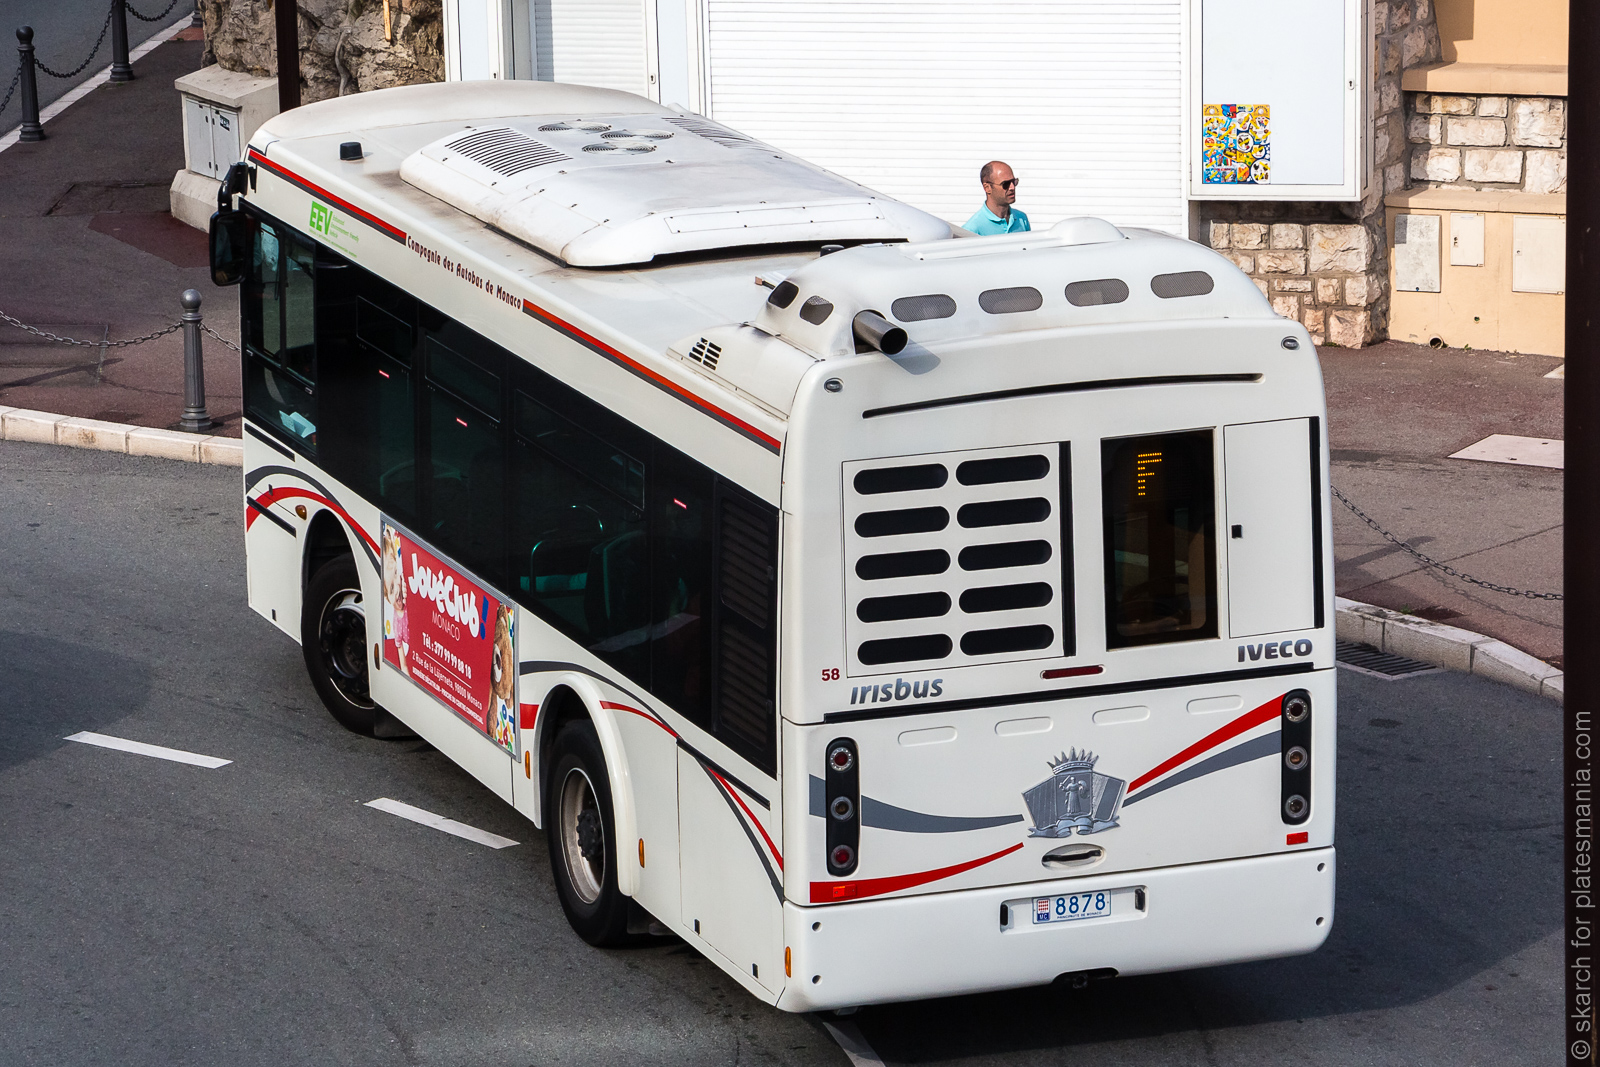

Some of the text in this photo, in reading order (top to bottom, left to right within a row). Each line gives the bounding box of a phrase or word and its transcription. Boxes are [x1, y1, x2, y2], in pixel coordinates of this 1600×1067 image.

[309, 201, 333, 235] EEV
[407, 235, 522, 309] Compagnie des Autobus de Monaco
[1137, 452, 1162, 496] F
[432, 610, 460, 641] MONACO
[434, 641, 444, 658] 377
[444, 648, 450, 663] 99
[451, 653, 457, 668] 99
[457, 658, 464, 674] 88
[465, 664, 472, 679] 18
[1238, 639, 1313, 663] IVECO
[412, 650, 416, 660] 2
[416, 653, 424, 666] Rue
[423, 660, 429, 670] de
[429, 663, 434, 674] la
[466, 691, 482, 710] Monaco
[821, 668, 841, 681] 58
[1056, 893, 1106, 915] 8878
